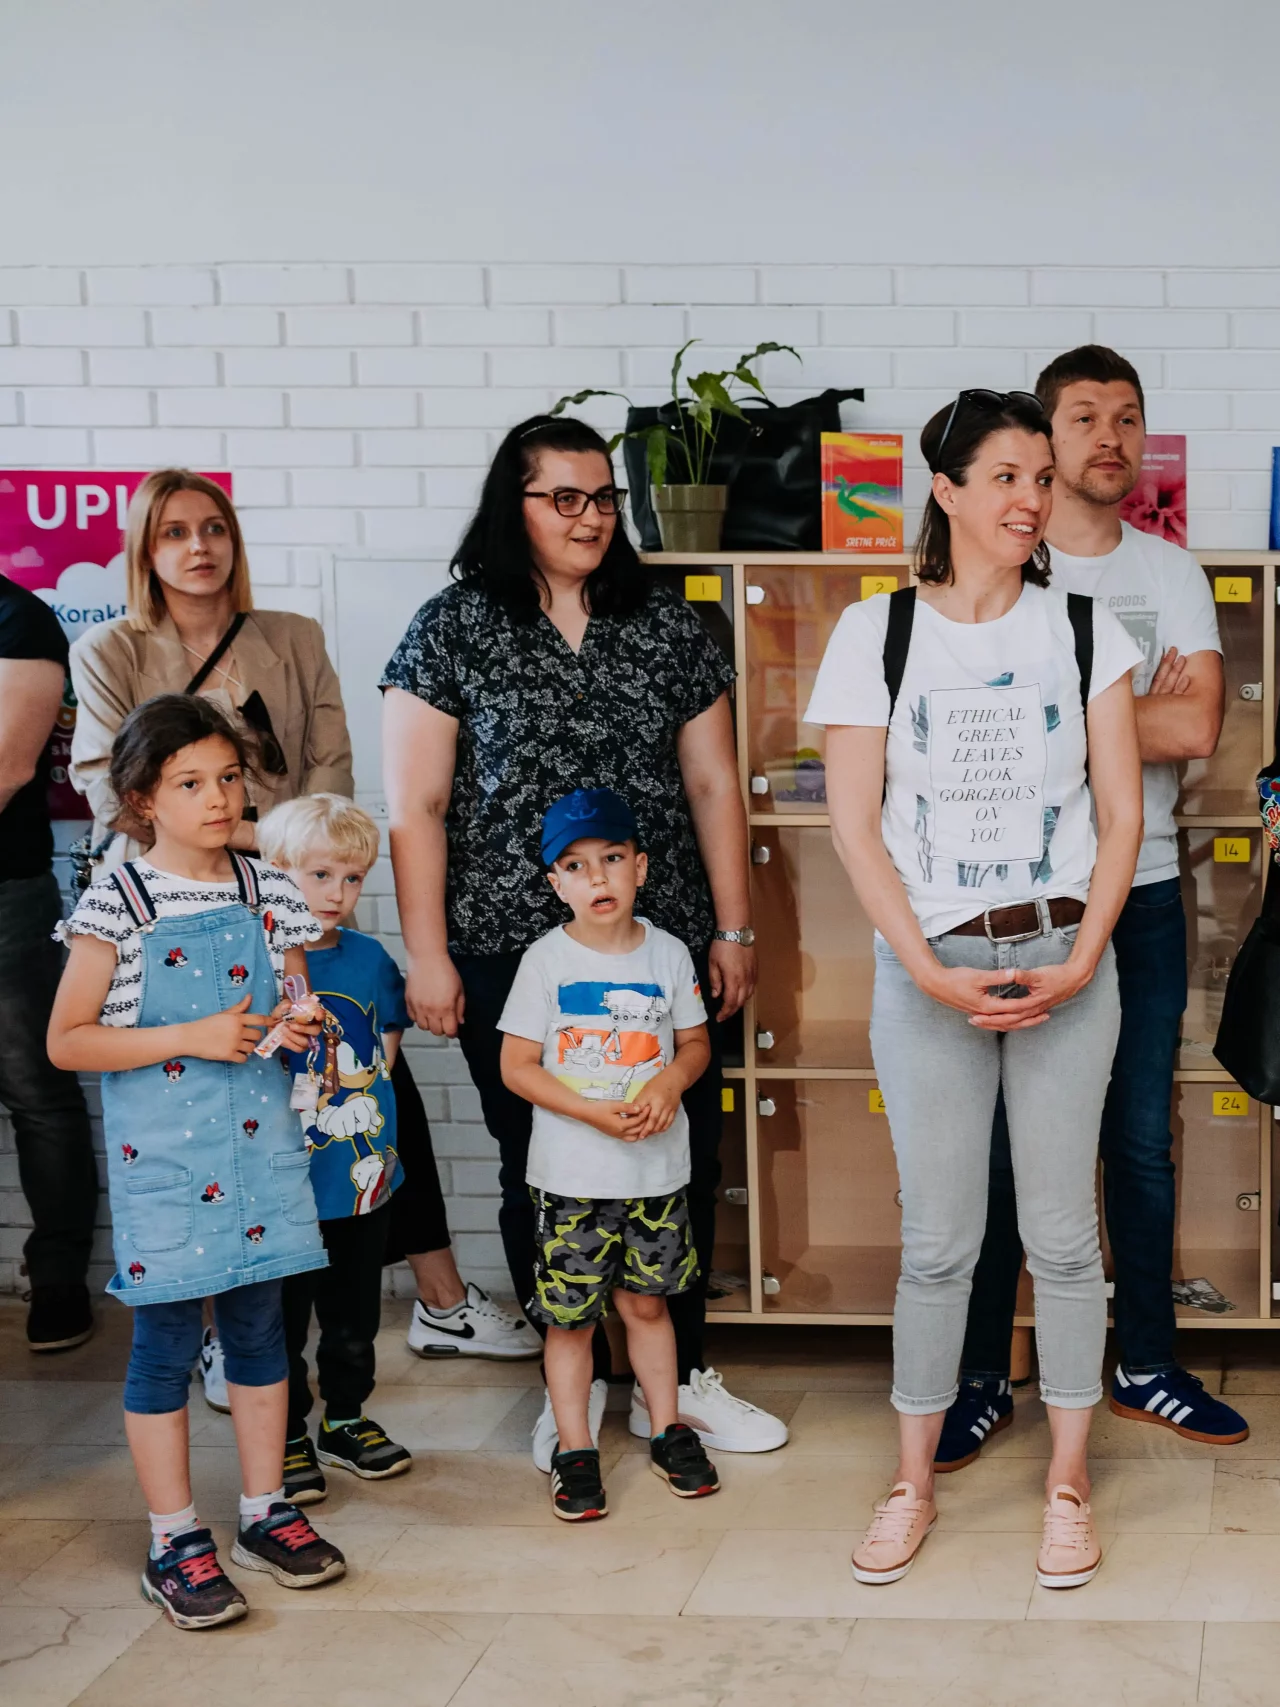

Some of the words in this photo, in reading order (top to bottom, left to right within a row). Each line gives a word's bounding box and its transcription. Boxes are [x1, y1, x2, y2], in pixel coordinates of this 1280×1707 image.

[26, 484, 128, 530] UPI
[845, 537, 874, 547] SRETNE
[875, 582, 885, 594] 2
[1228, 583, 1239, 597] 4
[1108, 594, 1147, 608] GOODS
[946, 707, 1026, 725] ETHICAL
[958, 727, 1021, 743] GREEN
[951, 746, 1024, 763] LEAVES
[961, 767, 1016, 783] LOOK
[939, 785, 1037, 802] GORGEOUS
[975, 806, 1002, 822] ON
[970, 827, 1007, 843] YOU
[1224, 843, 1239, 857] 14
[1221, 1096, 1241, 1110] 24
